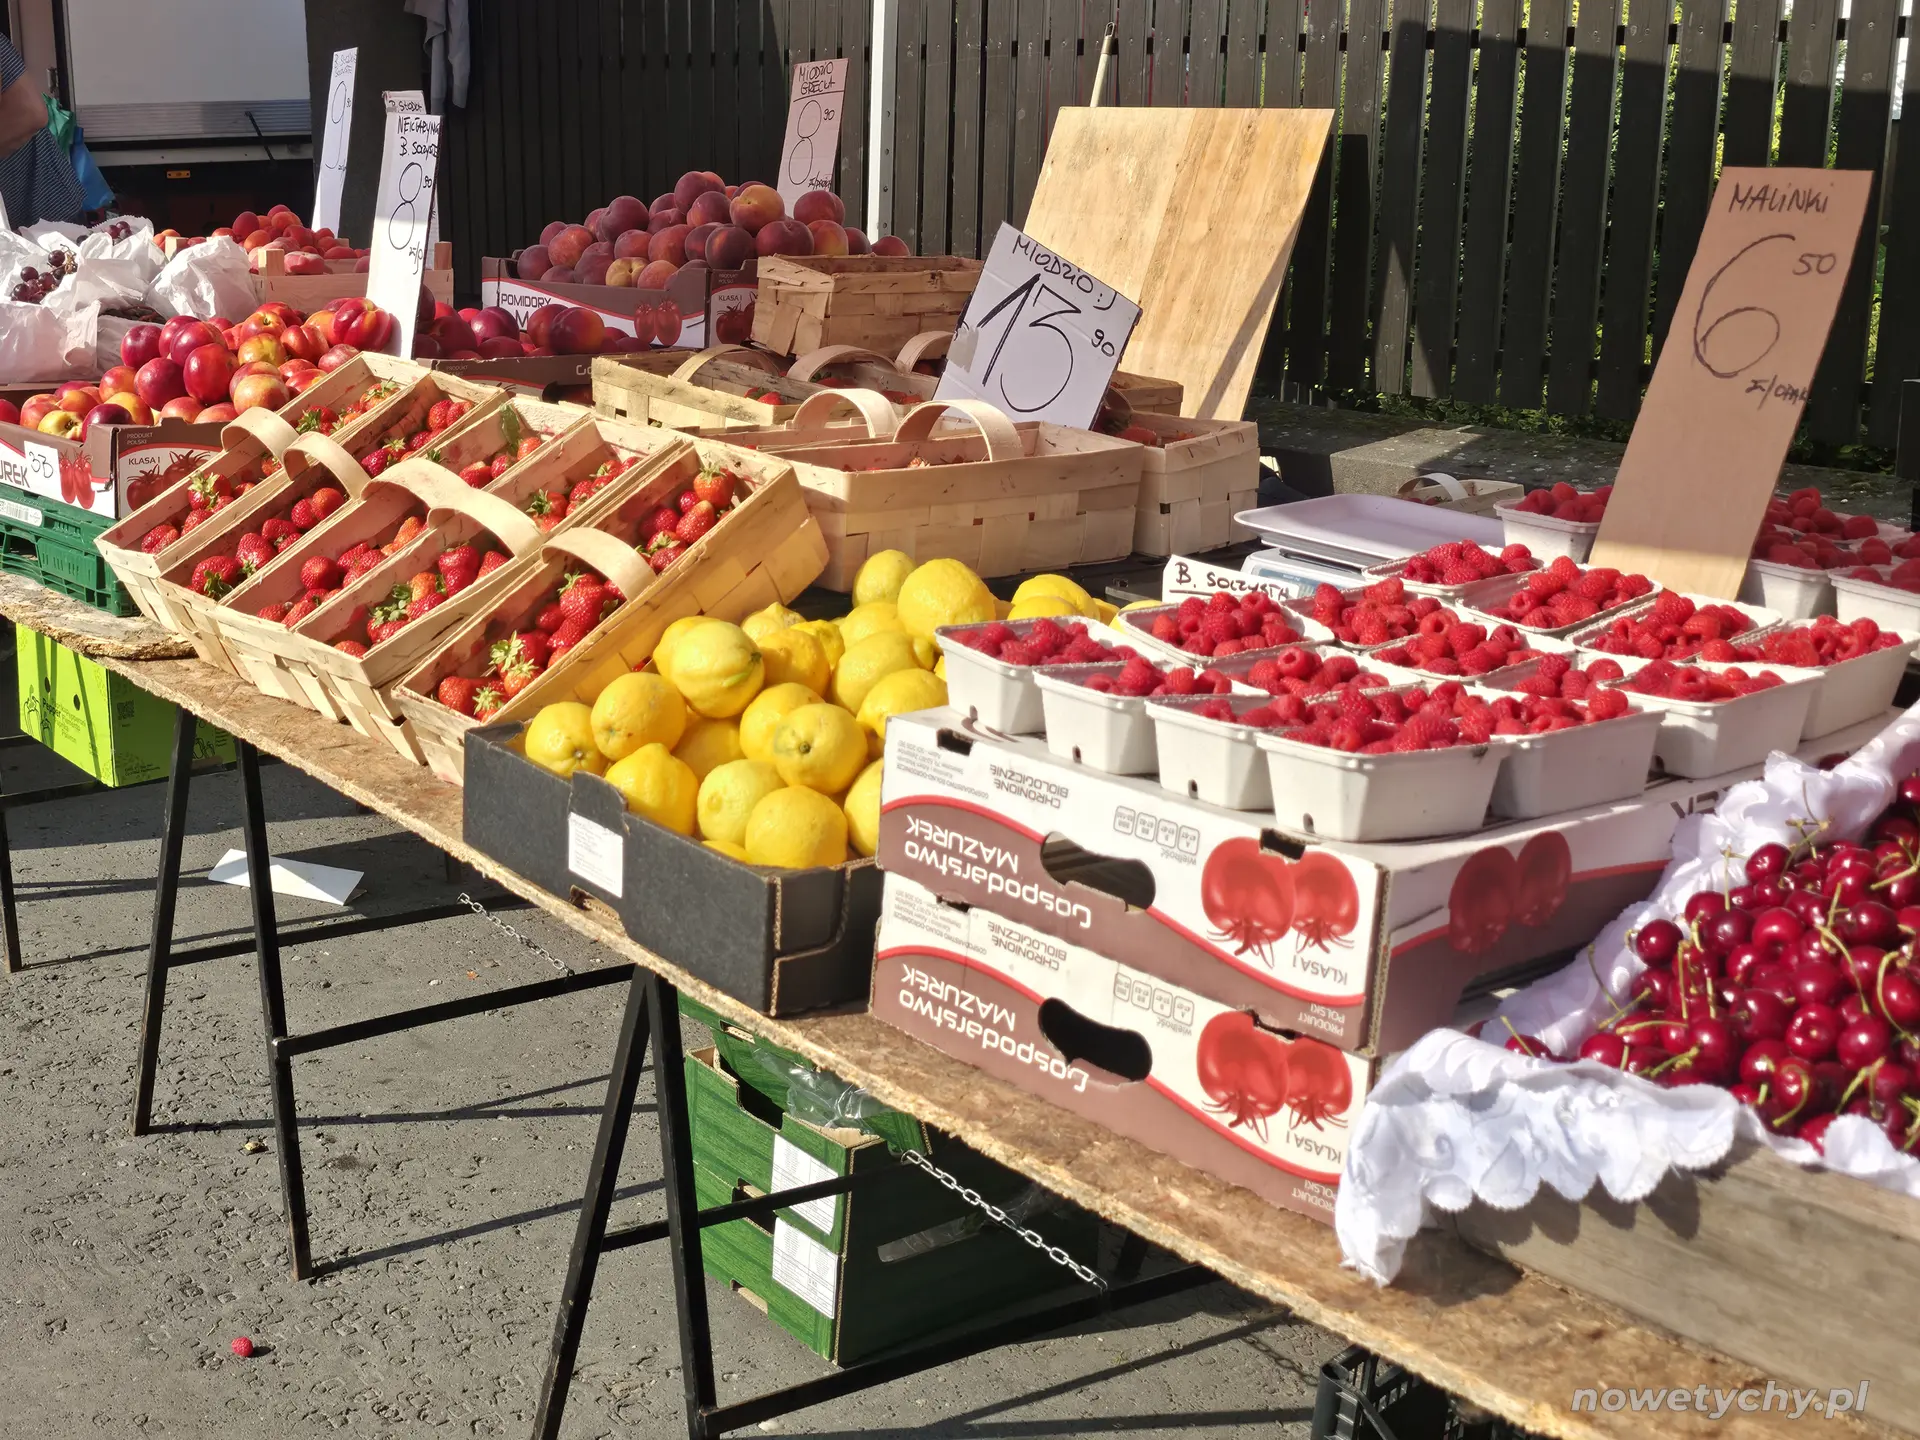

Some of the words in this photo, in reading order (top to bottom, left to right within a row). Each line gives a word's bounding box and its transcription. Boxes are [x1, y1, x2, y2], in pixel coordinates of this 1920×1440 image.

[325, 80, 347, 170] 9
[823, 108, 835, 121] 90
[399, 136, 410, 157] B.
[788, 99, 822, 185] 8
[388, 161, 423, 250] 8
[1728, 181, 1835, 214] MALINKI
[1012, 234, 1094, 294] MIODZIO
[1791, 252, 1836, 276] 50
[501, 292, 551, 309] POMIDORY
[718, 294, 739, 302] KLASA
[1692, 233, 1796, 379] 6
[977, 273, 1082, 413] 13
[1091, 328, 1116, 358] 90
[126, 432, 154, 440] PRODUKT
[126, 438, 149, 446] POLSKI
[128, 456, 156, 467] KLASA
[1174, 561, 1197, 589] B.
[989, 763, 1069, 799] BIOLOGICZNIE
[992, 778, 1062, 810] CHRONIONE
[905, 814, 1019, 874] MAZUREK
[904, 840, 1092, 929] Gospodarstwo
[987, 921, 1068, 961] BIOLOGICZNIE
[990, 934, 1060, 972] CHRONIONE
[1300, 957, 1349, 986] KLASA
[900, 963, 1017, 1032] MAZUREK
[1310, 1002, 1346, 1024] POLSKI
[1296, 1010, 1344, 1037] PRODUKT
[898, 989, 1090, 1093] Gospodarstwo
[1293, 1136, 1342, 1165] KLASA
